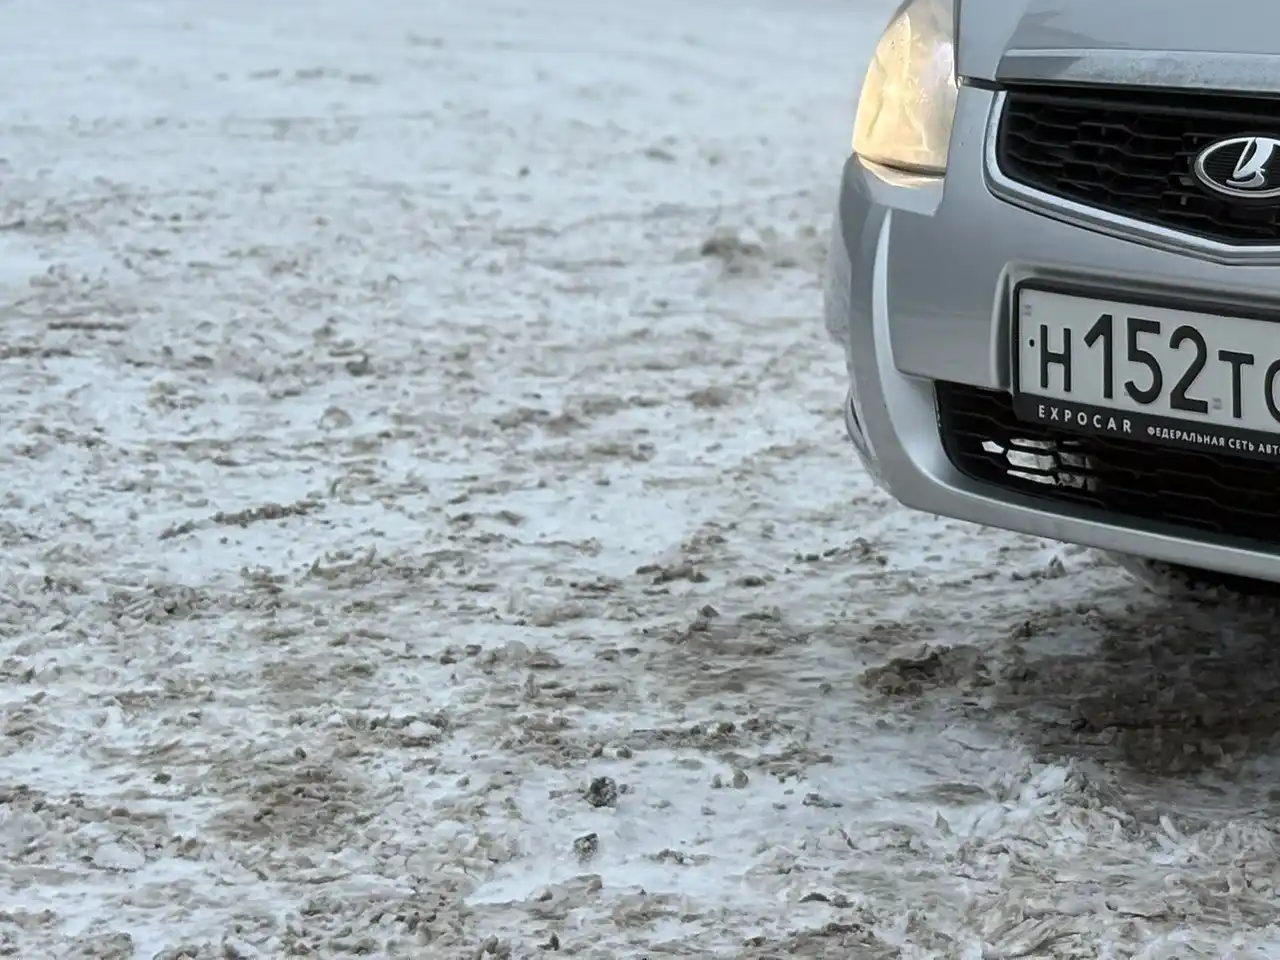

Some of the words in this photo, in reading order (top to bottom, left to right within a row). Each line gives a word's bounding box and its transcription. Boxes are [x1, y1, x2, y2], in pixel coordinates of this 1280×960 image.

[1038, 404, 1132, 433] EXPOCAR
[1147, 426, 1225, 447] ФЕДЕРАЛЬНАЯ
[1228, 438, 1255, 452] СЕТЬ
